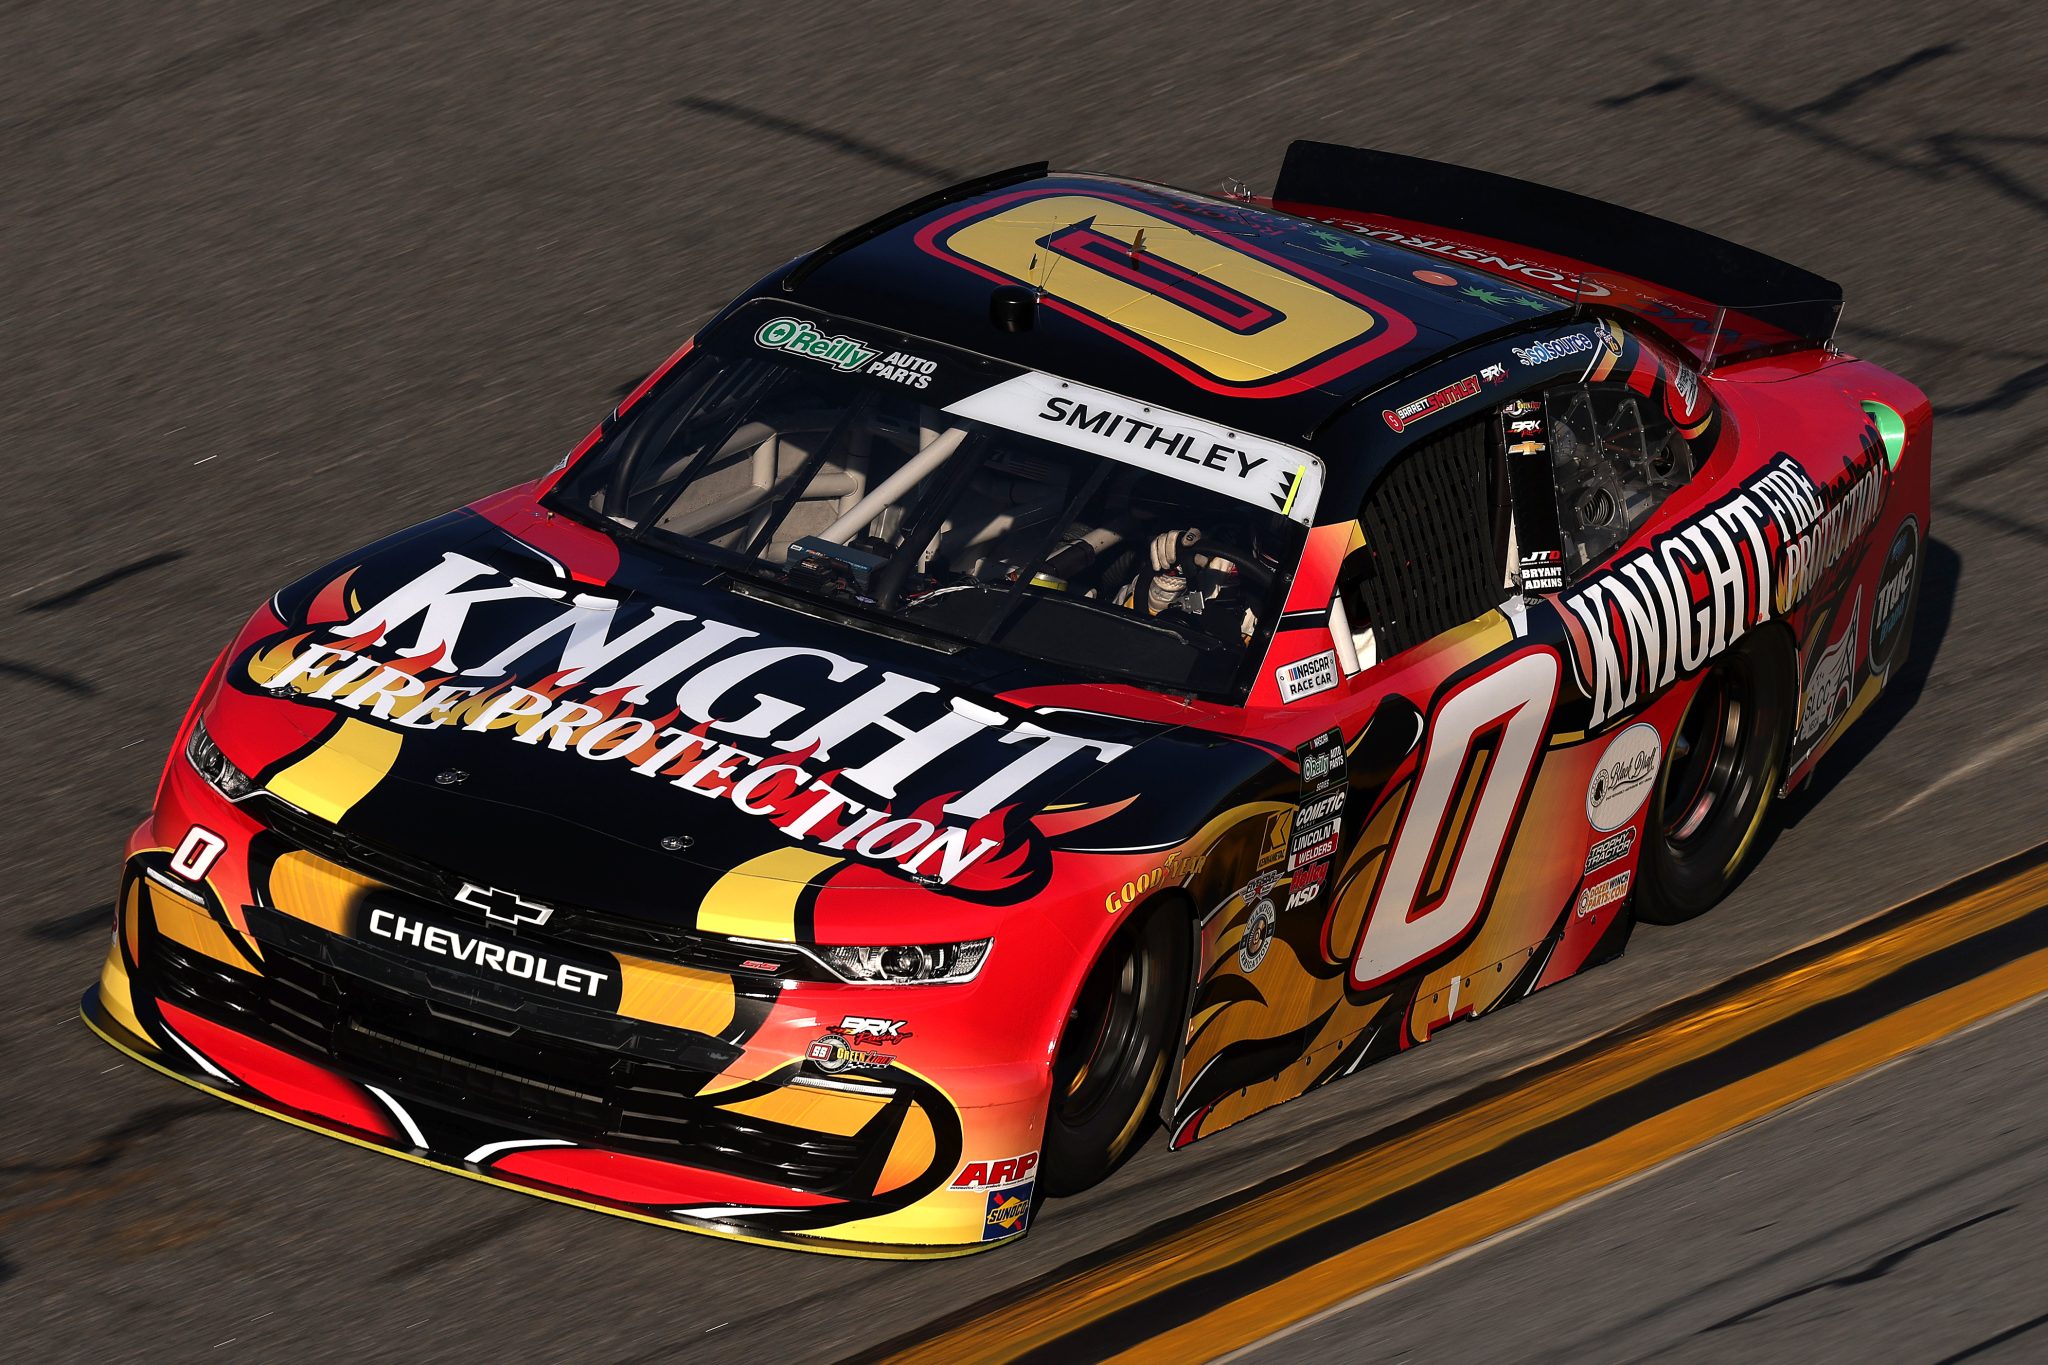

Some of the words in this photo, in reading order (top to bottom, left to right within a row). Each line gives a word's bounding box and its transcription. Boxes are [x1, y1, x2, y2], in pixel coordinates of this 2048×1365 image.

[947, 195, 1375, 382] 0
[759, 319, 874, 371] O'Reilly
[1529, 332, 1593, 366] solsource
[867, 361, 932, 389] PARTS
[883, 351, 938, 375] AUTO
[1426, 376, 1480, 408] SMITHLEY
[1039, 396, 1271, 479] SMITHLEY
[1750, 458, 1825, 542] FIRE
[1785, 457, 1884, 611] PROTECTION
[1521, 567, 1562, 579] BRYANT
[1525, 578, 1563, 589] ADKINS
[1567, 494, 1771, 729] KNIGHT
[1290, 679, 1314, 694] RACE
[1315, 673, 1331, 686] CAR
[1296, 656, 1330, 679] NASCAR
[330, 551, 1132, 819] KNIGHT
[261, 643, 485, 730] FIRE
[462, 686, 1000, 886] PROTECTION
[1329, 755, 1344, 770] PARTS
[1330, 745, 1342, 759] AUTO
[1607, 757, 1634, 791] Black
[1296, 791, 1345, 826] COMETIC
[1354, 652, 1558, 983] 0
[170, 826, 225, 881] 0
[1293, 822, 1331, 852] LINCOLN
[1298, 841, 1332, 864] WELDERS
[1587, 839, 1632, 868] TRACTOR
[1591, 831, 1630, 857] TROPHY
[1105, 851, 1206, 914] GOODYEAR
[1290, 861, 1330, 894] Holley
[1285, 884, 1320, 912] MSD
[368, 907, 608, 997] CHEVROLET
[840, 1016, 907, 1036] BRK
[951, 1152, 1039, 1187] ARP
[987, 1200, 1029, 1224] SUNOCO
